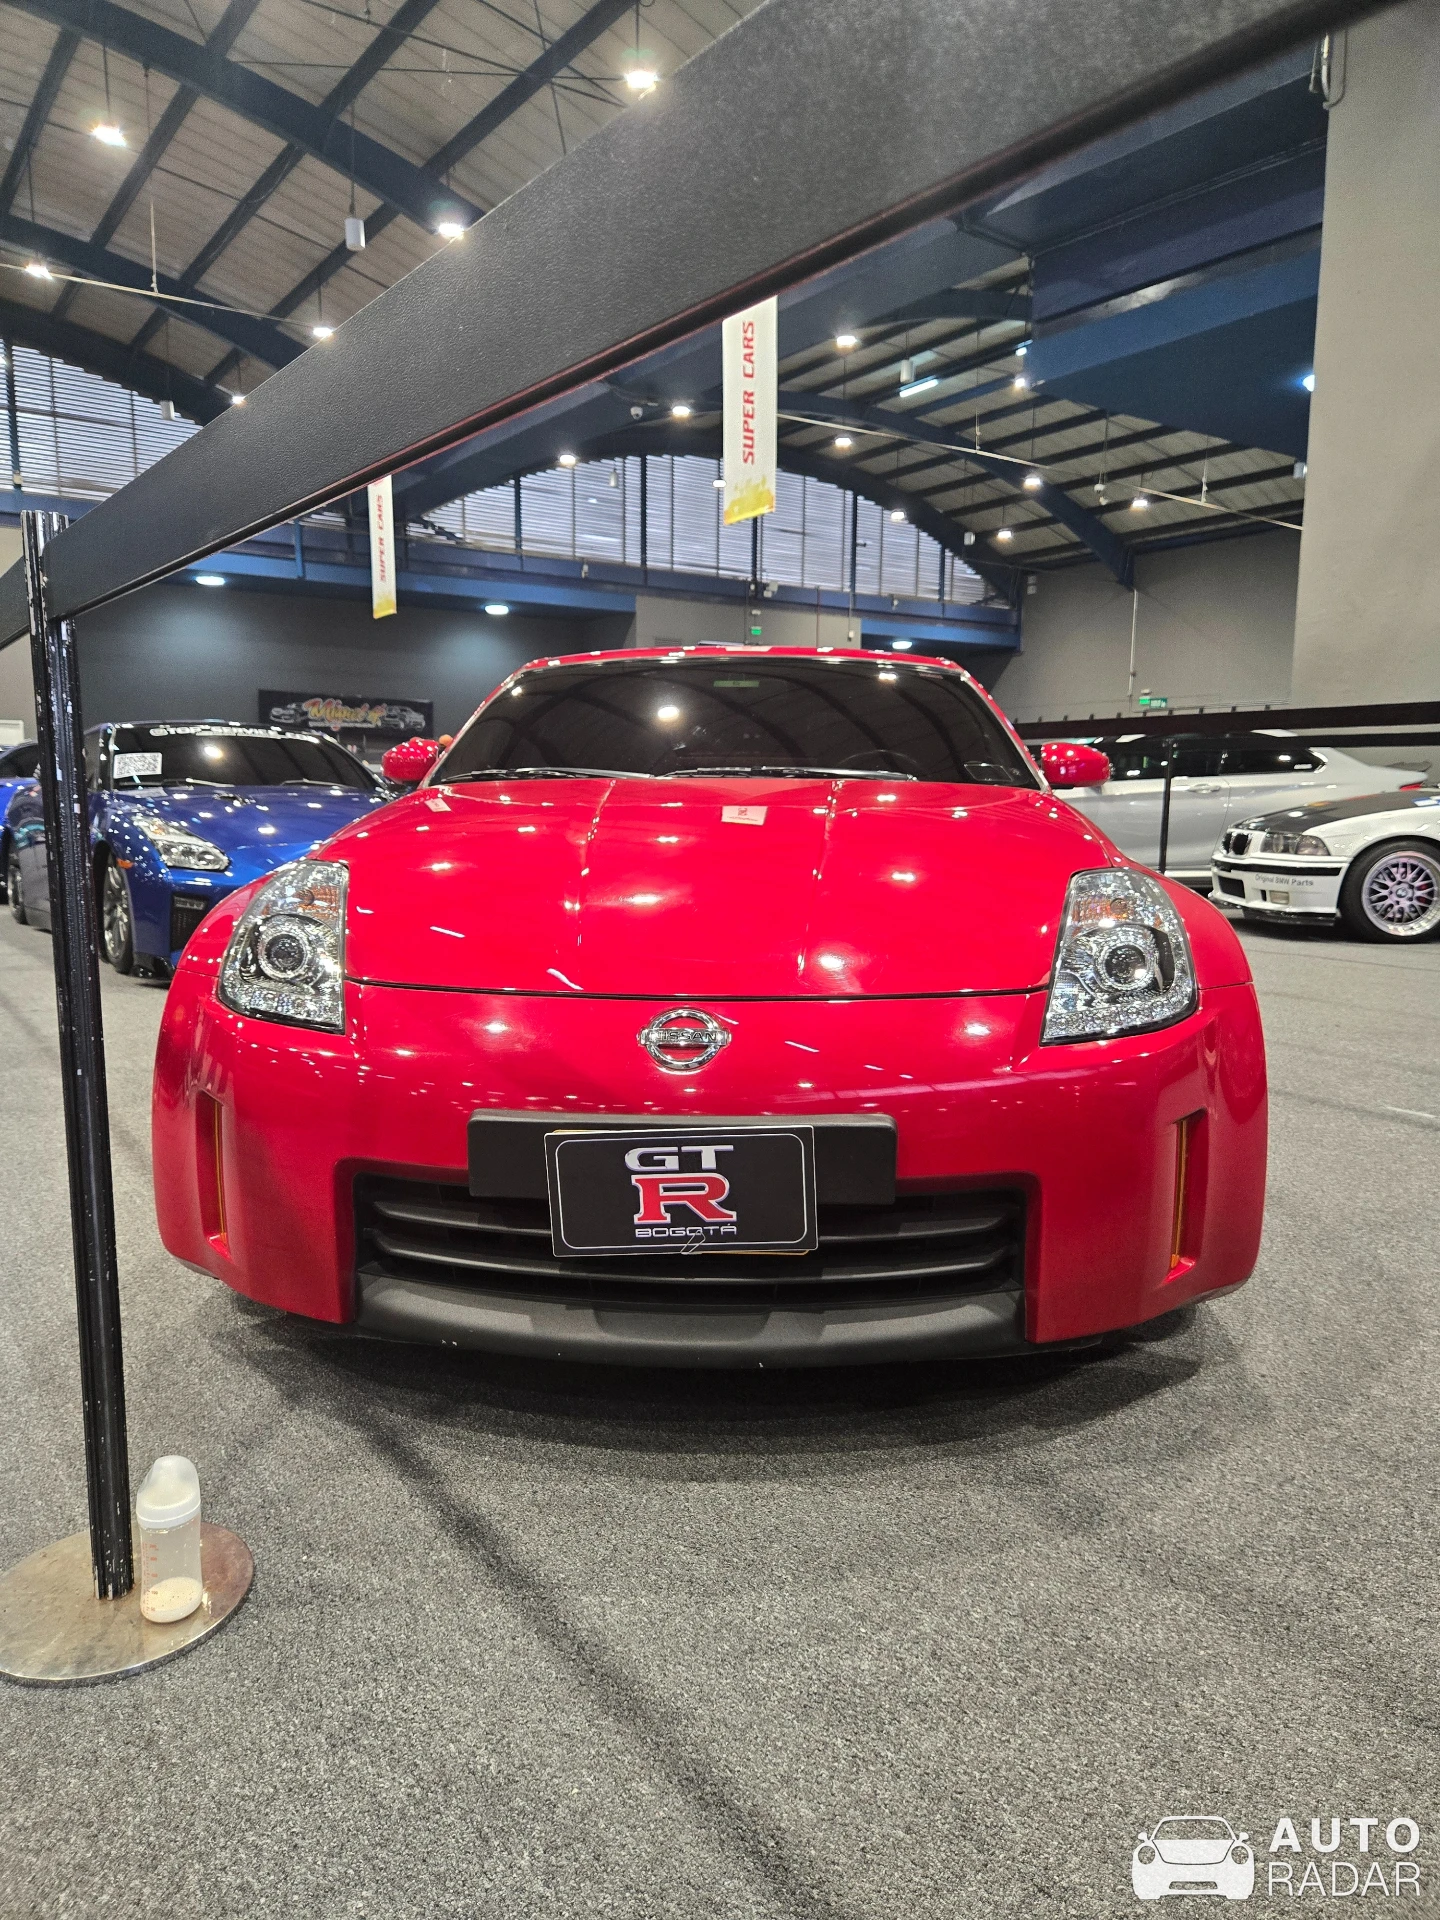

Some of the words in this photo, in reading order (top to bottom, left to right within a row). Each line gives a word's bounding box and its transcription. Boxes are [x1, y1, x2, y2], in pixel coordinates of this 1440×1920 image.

[742, 320, 755, 379] CARS
[742, 390, 755, 465] SUPER
[1255, 874, 1274, 883] Original
[1275, 876, 1290, 885] BMW
[1291, 878, 1314, 886] Parts
[649, 1031, 718, 1043] NISSAN
[624, 1144, 734, 1172] GT
[630, 1172, 737, 1225] R
[635, 1223, 737, 1238] BOGOTÁ
